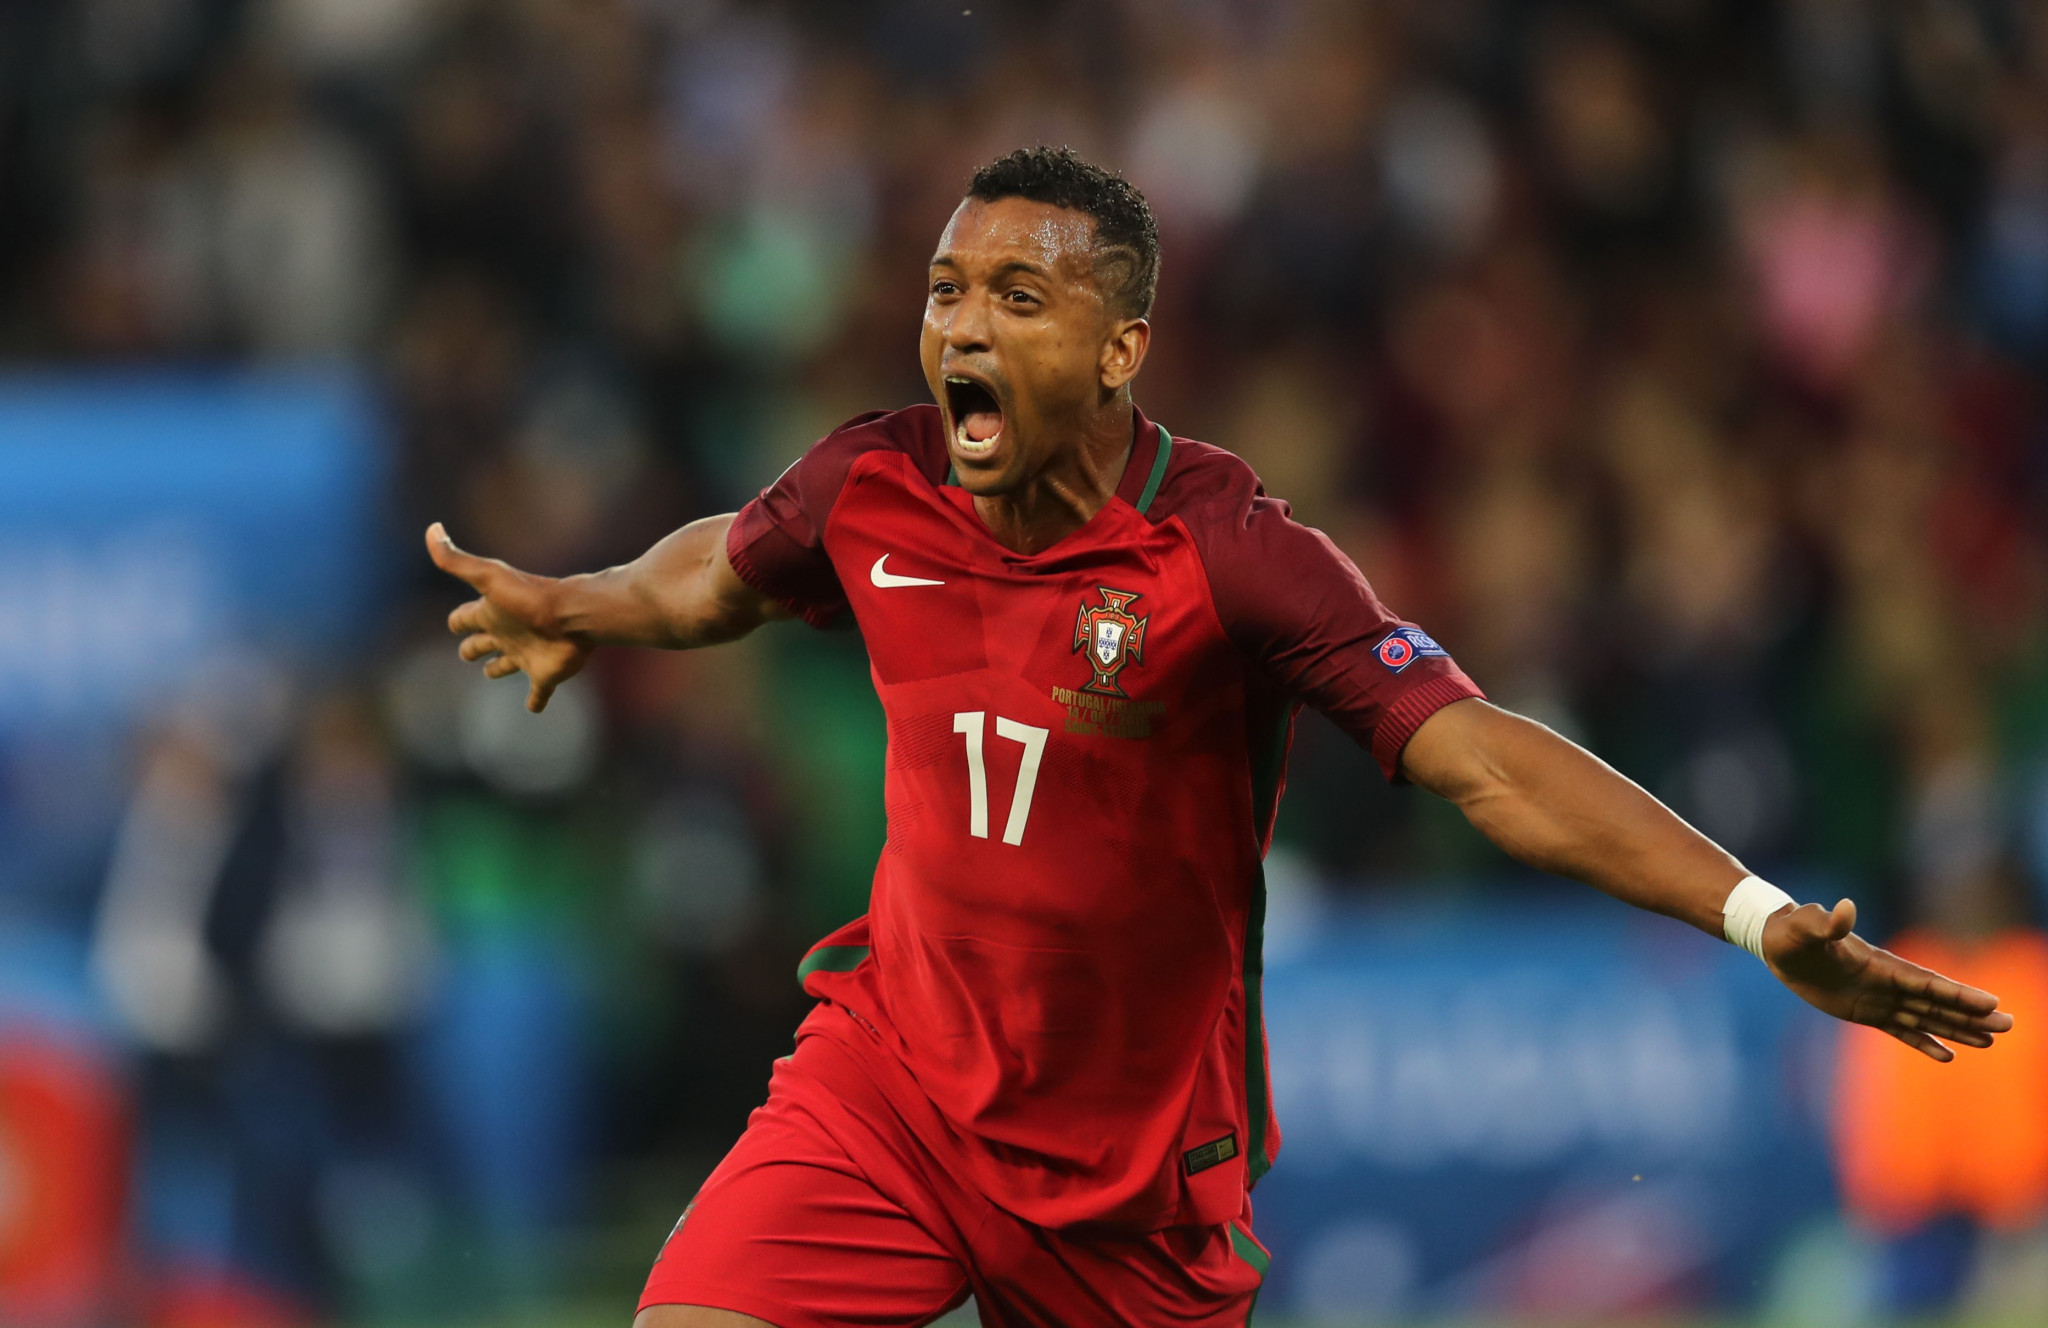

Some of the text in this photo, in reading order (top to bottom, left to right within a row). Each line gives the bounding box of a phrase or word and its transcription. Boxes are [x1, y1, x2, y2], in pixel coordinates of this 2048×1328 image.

[1382, 639, 1398, 654] UEFA
[1066, 705, 1080, 718] 14
[953, 711, 1050, 847] 17
